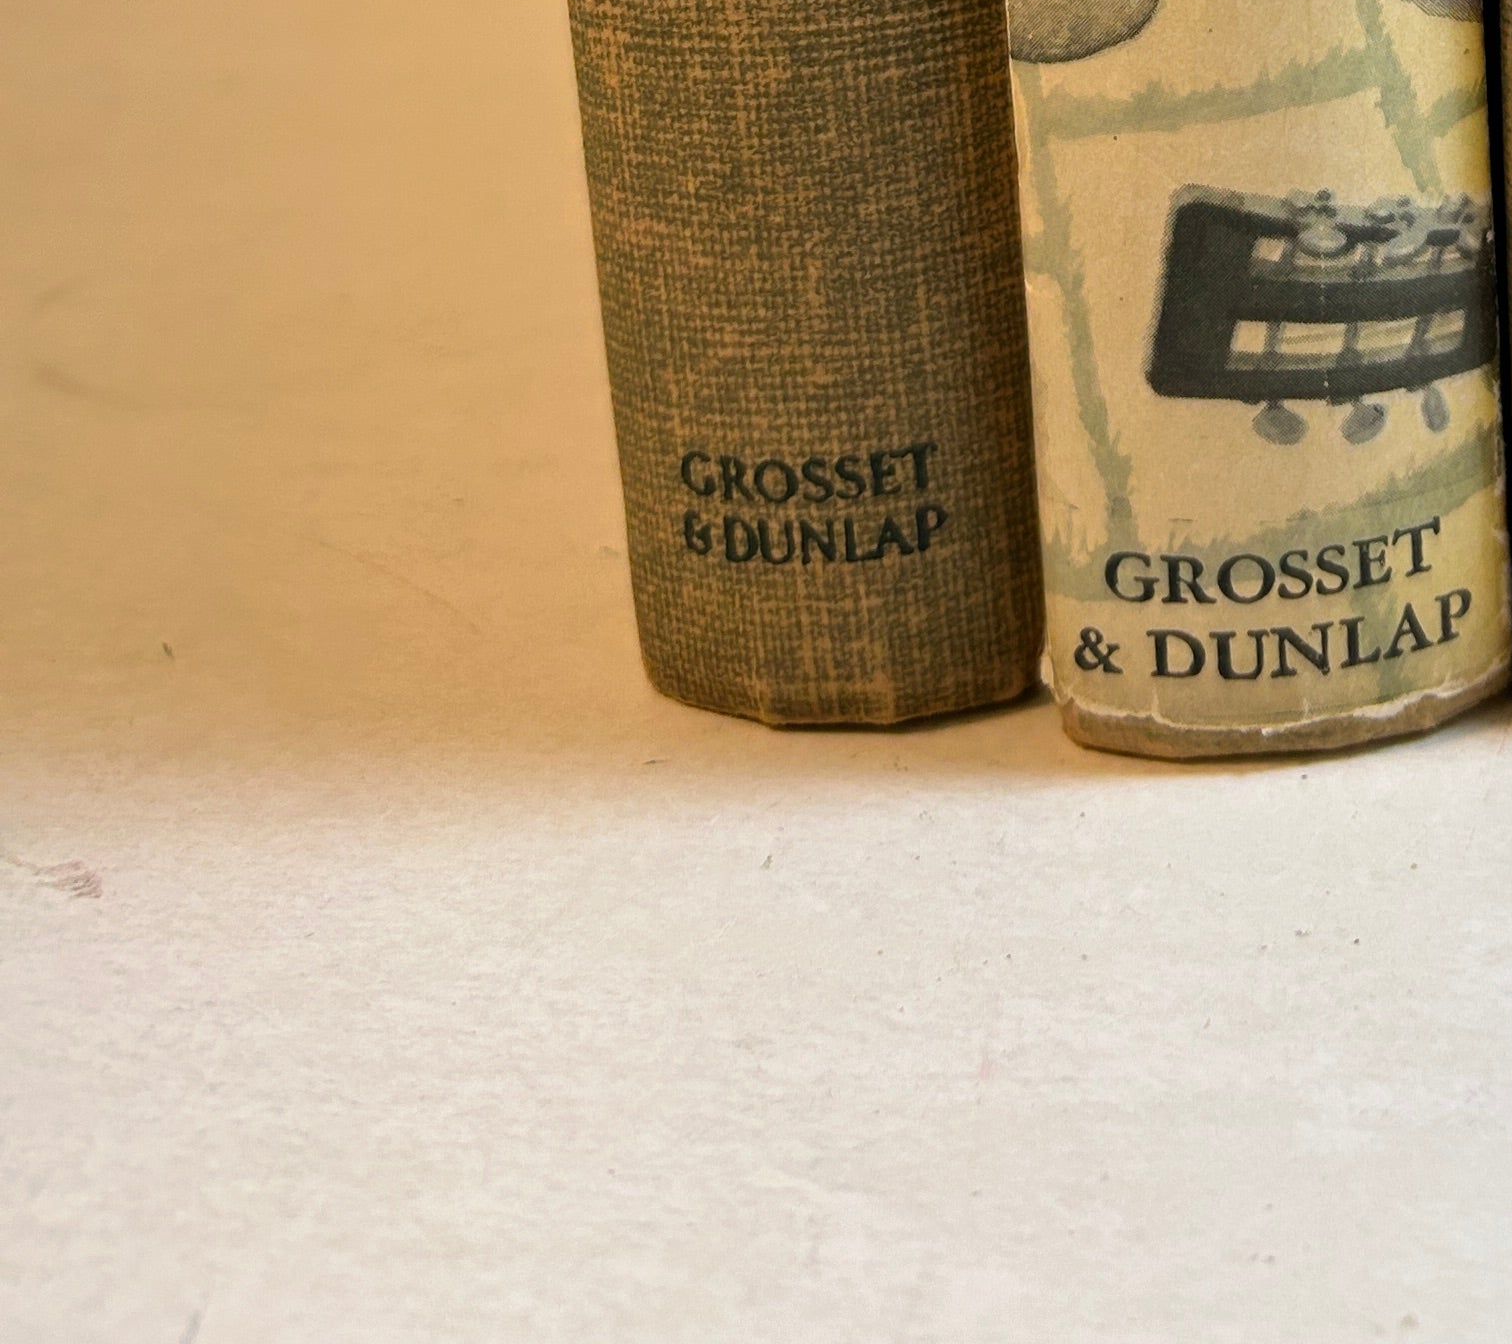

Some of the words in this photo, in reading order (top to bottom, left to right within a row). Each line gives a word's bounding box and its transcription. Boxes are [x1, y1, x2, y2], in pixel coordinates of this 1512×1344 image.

[681, 441, 938, 503] GROSSET
[1104, 516, 1441, 604] GROSSET
[1074, 627, 1123, 674] &
[1146, 587, 1472, 680] DUNLAP
